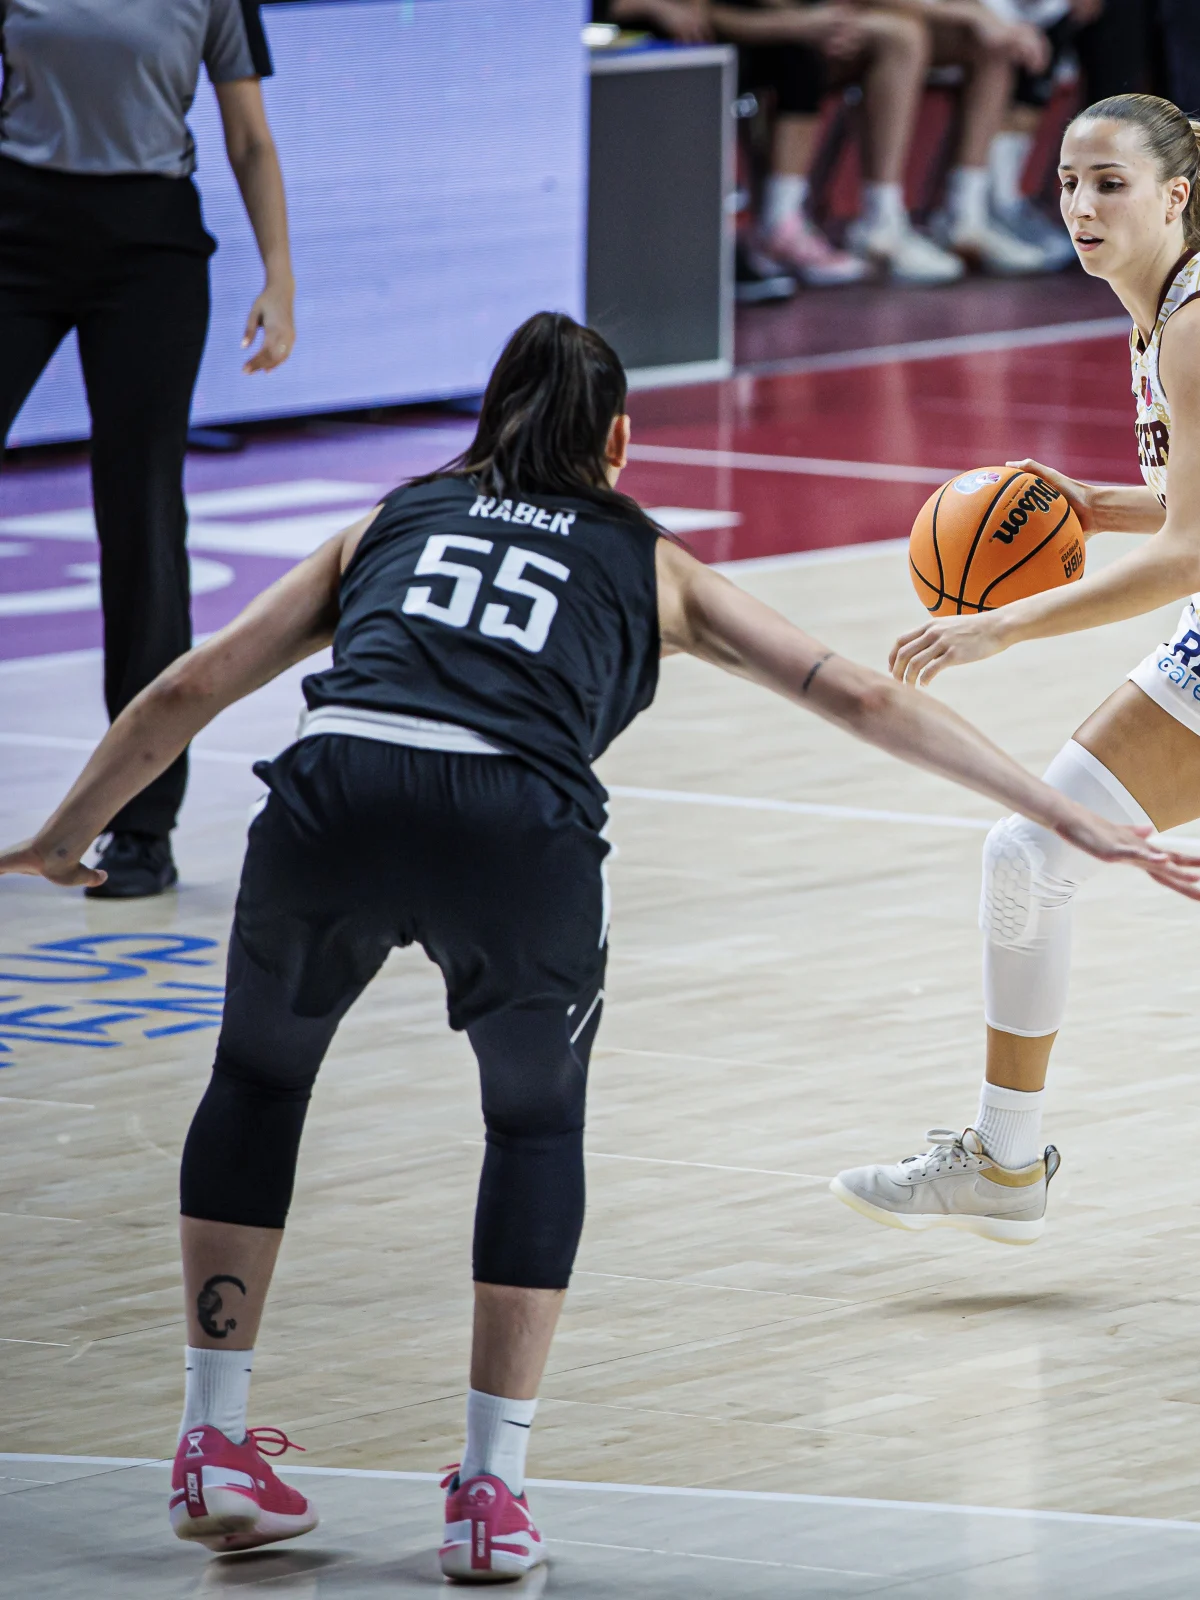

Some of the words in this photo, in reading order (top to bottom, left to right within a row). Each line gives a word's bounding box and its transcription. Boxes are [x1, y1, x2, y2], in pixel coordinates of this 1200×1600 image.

[468, 494, 577, 536] RABER
[1063, 546, 1083, 579] FIBA
[402, 533, 571, 653] 55
